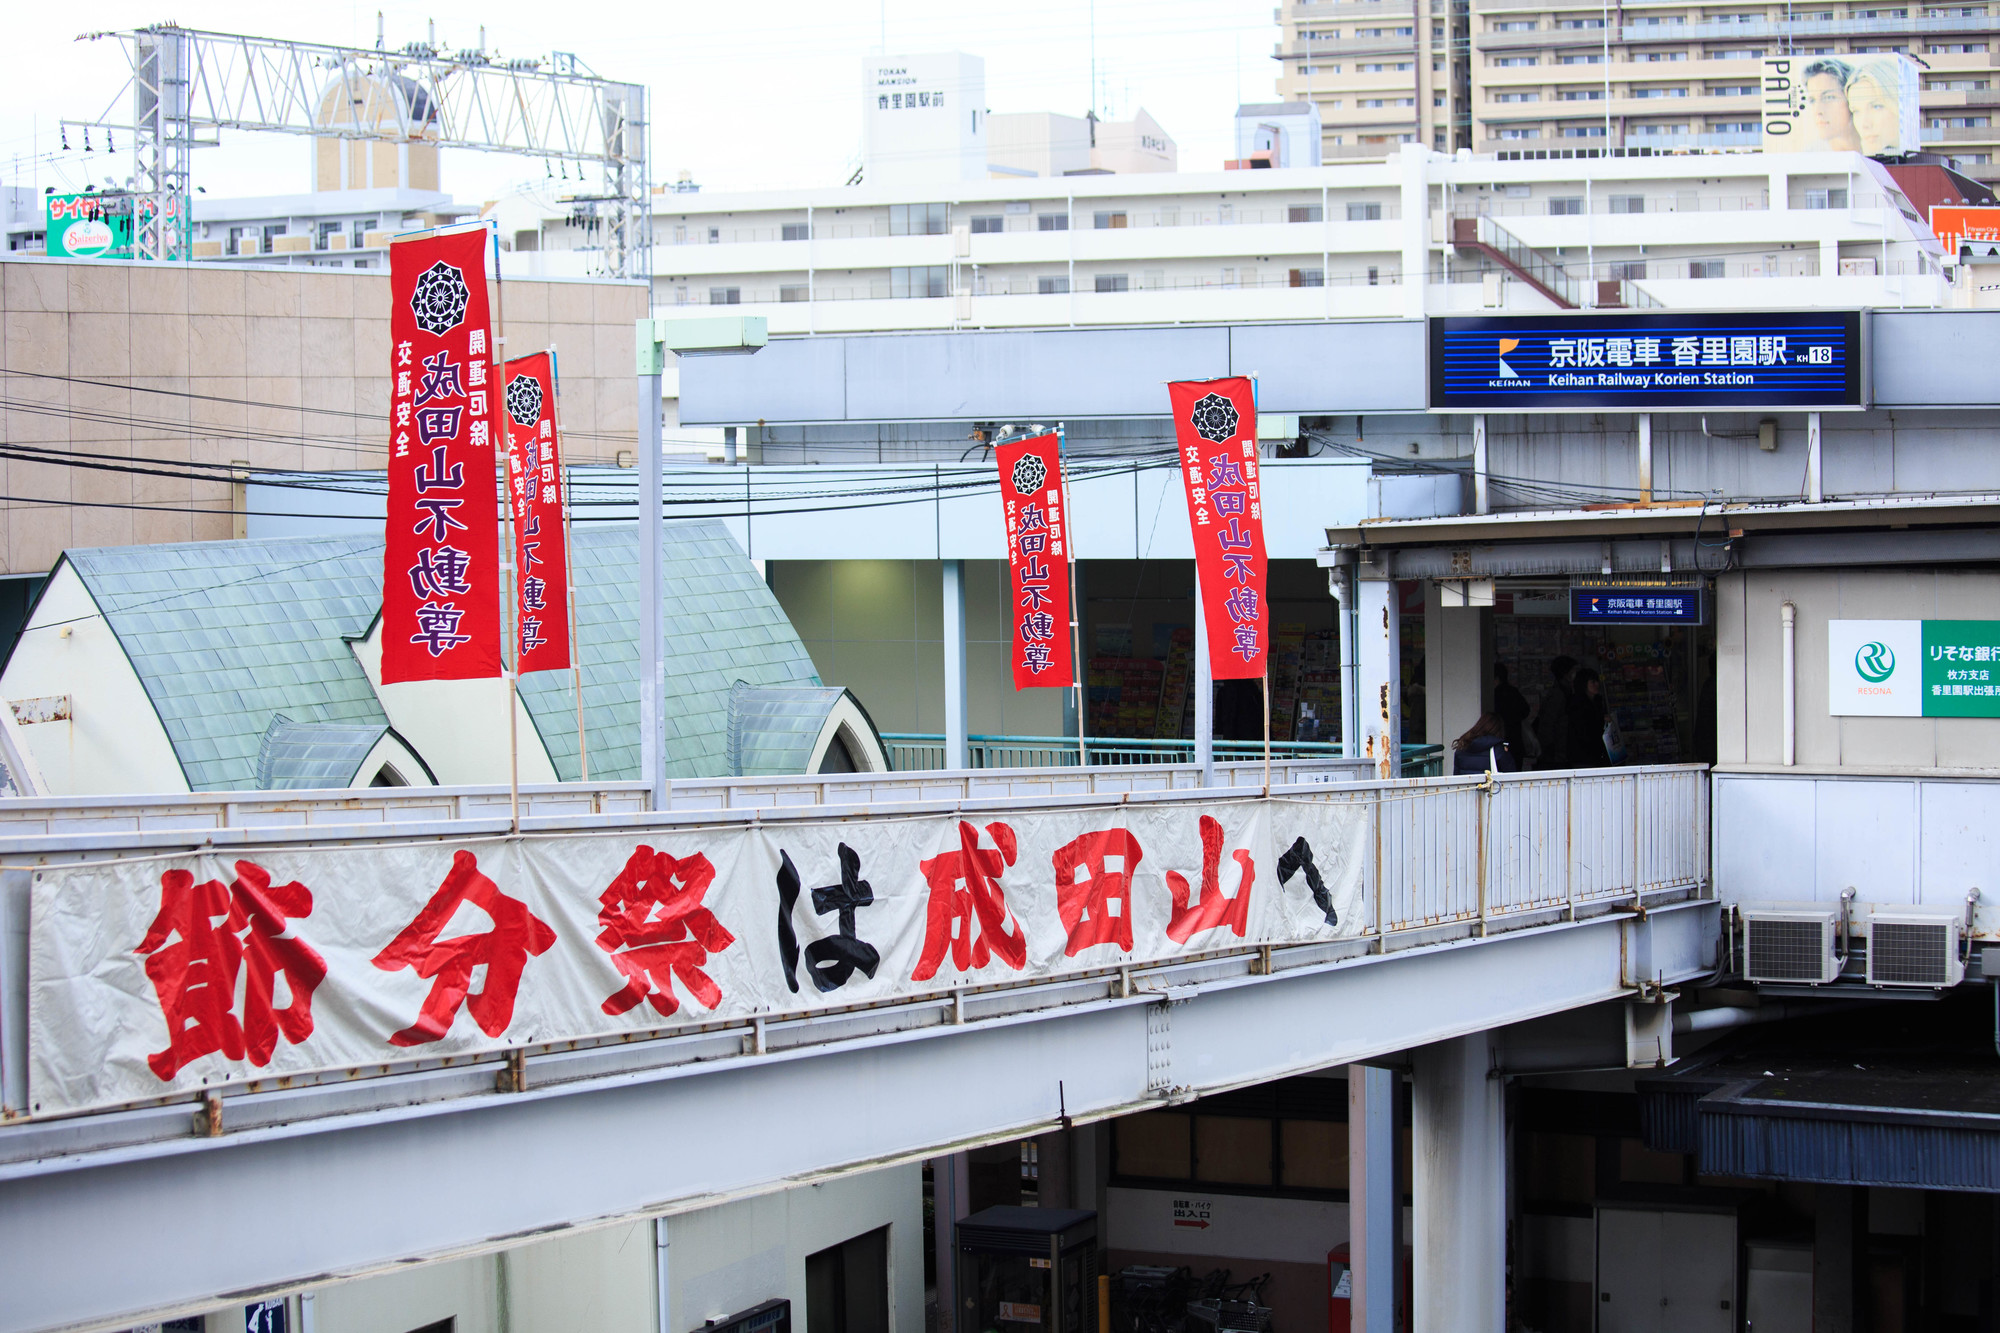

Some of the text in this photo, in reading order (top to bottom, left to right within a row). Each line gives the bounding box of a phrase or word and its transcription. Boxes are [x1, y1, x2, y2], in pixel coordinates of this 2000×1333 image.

[878, 68, 907, 76] TOKAN
[878, 78, 917, 86] MANSION
[878, 92, 944, 109] 香里園駅前
[1765, 60, 1791, 135] PATIO
[1548, 337, 1661, 368] 京阪電車
[1671, 336, 1788, 366] 香里園駅
[1489, 379, 1531, 387] KEIHAN
[1548, 371, 1754, 388] Keihan Railway Korien Station
[1607, 598, 1683, 609] 京阪電車 香里園駅
[1930, 645, 2000, 662] りそな銀行
[1947, 669, 1989, 681] 枚方支店
[1857, 687, 1892, 695] RESONA
[134, 814, 1329, 1081] 節分祭は成田山へ
[1173, 1200, 1211, 1210] 自転車・バイク
[1174, 1209, 1210, 1218] 出入口
